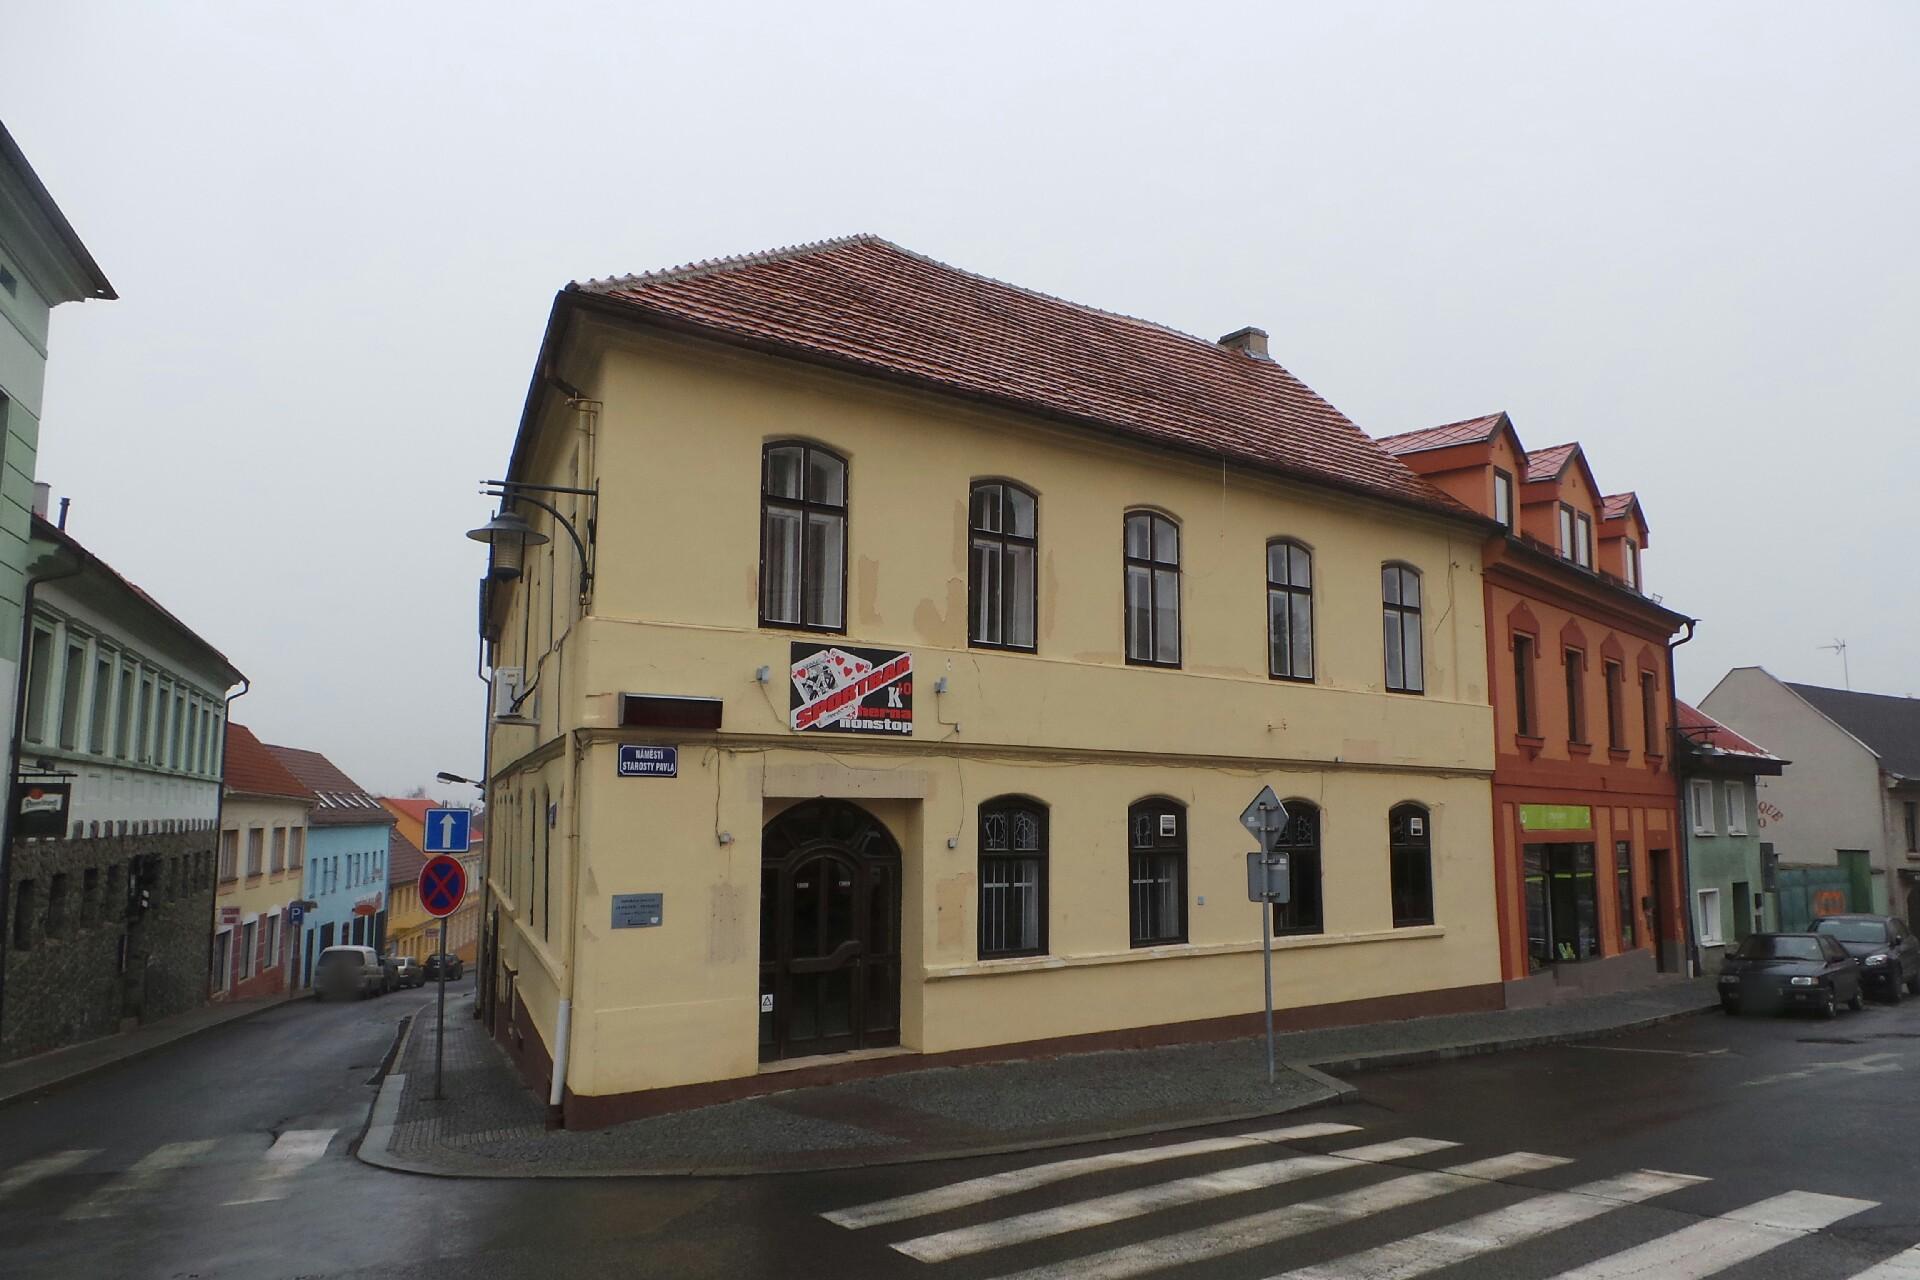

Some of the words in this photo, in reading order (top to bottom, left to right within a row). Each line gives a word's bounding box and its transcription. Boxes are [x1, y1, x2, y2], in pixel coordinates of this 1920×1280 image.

[796, 656, 910, 729] SPORTBAR
[887, 686, 903, 708] K
[857, 704, 912, 719] herna
[840, 718, 913, 734] nonstop
[622, 761, 655, 771] STAROSTY
[655, 762, 675, 772] PAVLA
[291, 907, 301, 919] P
